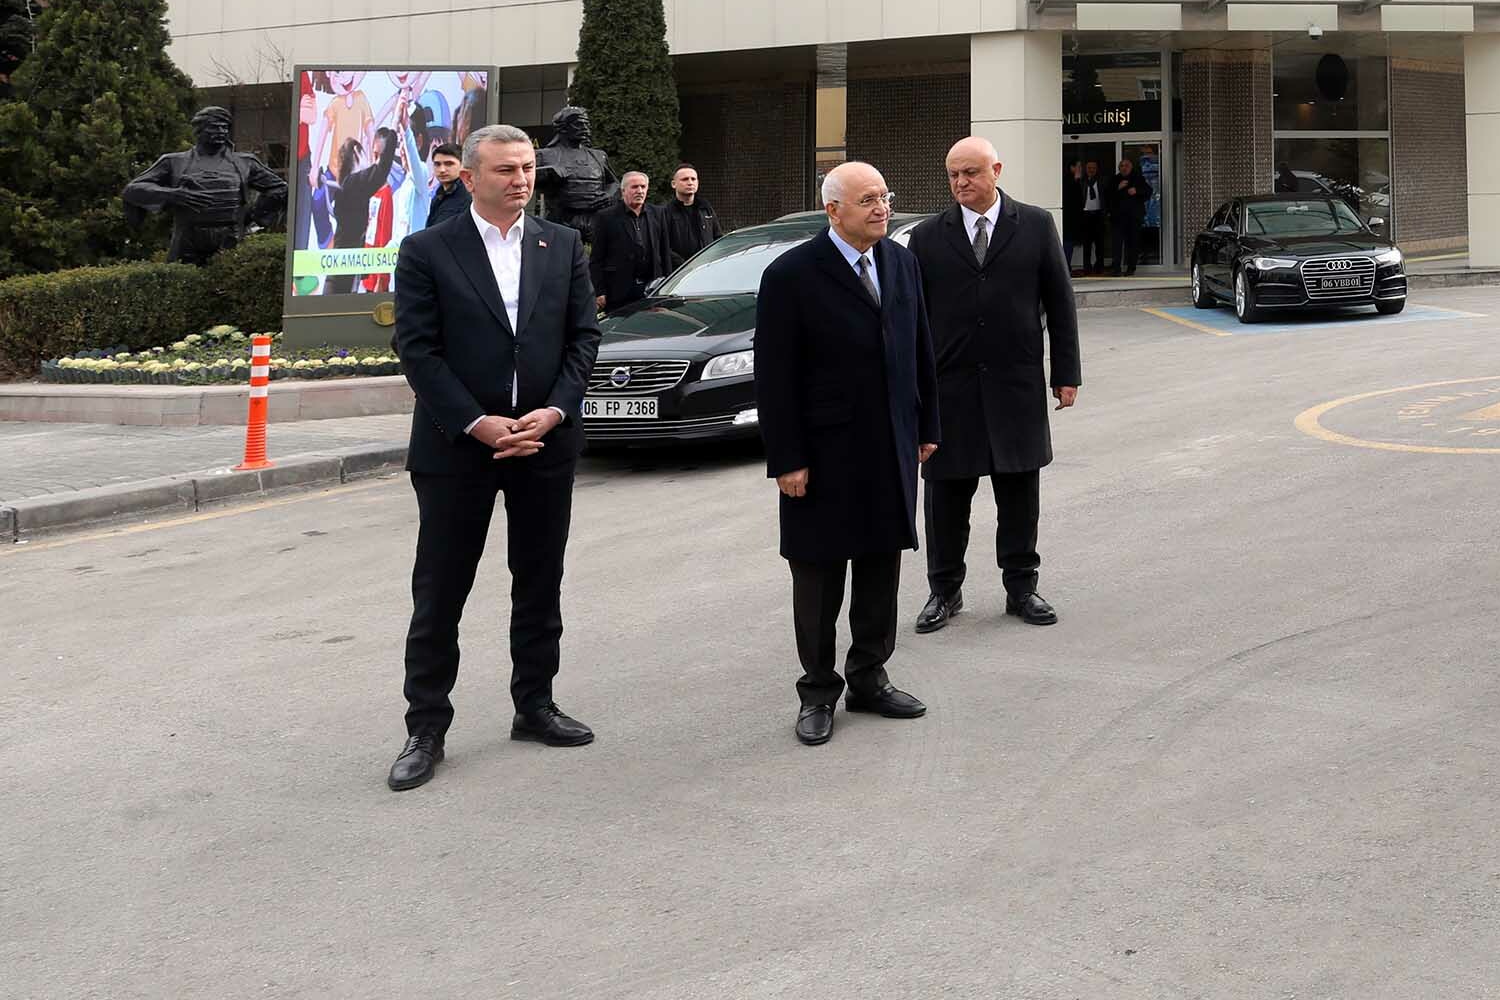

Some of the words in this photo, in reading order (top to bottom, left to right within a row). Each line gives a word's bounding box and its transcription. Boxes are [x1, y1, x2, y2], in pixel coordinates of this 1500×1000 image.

[1094, 108, 1131, 126] GİRİŞİ
[321, 255, 338, 271] ÇOK
[340, 253, 374, 271] AMAÇLI
[584, 401, 598, 415] 06
[606, 401, 620, 415] FP
[626, 401, 656, 415] 2368
